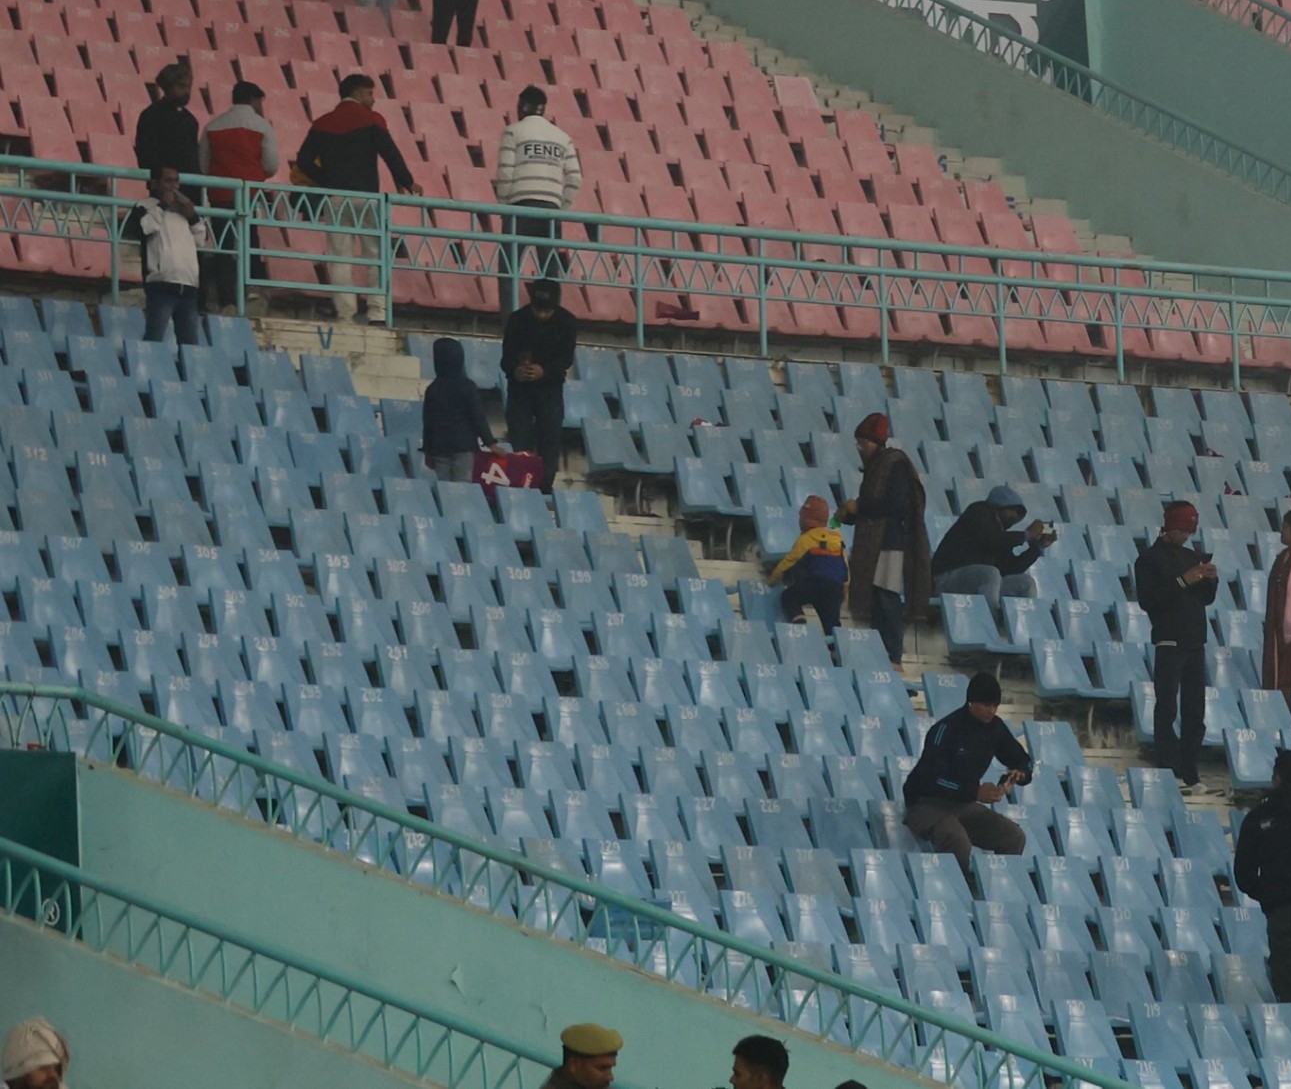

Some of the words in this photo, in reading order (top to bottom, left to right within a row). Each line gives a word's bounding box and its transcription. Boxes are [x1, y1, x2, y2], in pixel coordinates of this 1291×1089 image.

[25, 446, 48, 460] 312
[194, 545, 218, 559] 305
[324, 554, 349, 569] 303
[450, 563, 471, 576] 301
